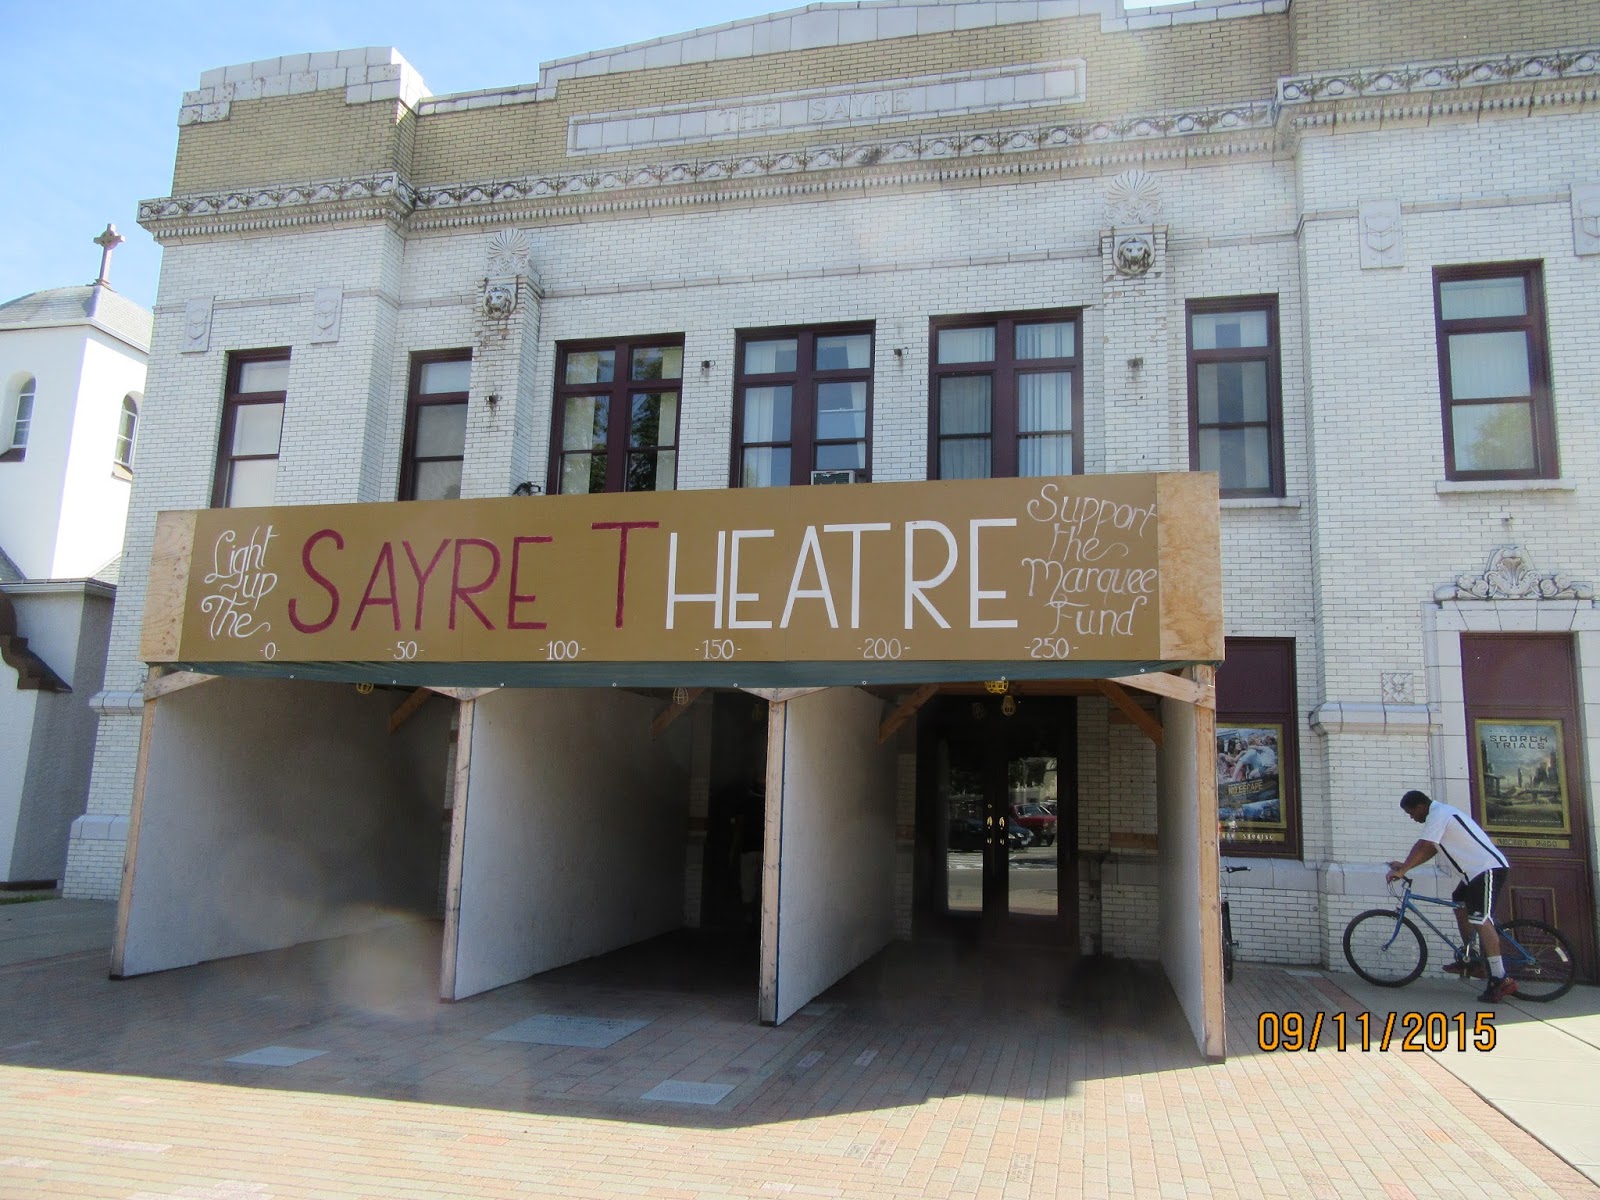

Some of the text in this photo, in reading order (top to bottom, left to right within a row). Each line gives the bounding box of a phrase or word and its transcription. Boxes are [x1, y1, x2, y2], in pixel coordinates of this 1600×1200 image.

[718, 91, 912, 132] THE SAYRE
[1026, 483, 1158, 538] Support
[204, 524, 280, 592] Light
[288, 518, 1018, 634] SAYRE THEATRE
[242, 572, 278, 611] up
[201, 591, 271, 640] The
[1044, 595, 1148, 637] Fund
[1489, 734, 1549, 743] SCORCH
[1494, 741, 1546, 750] TRIALS
